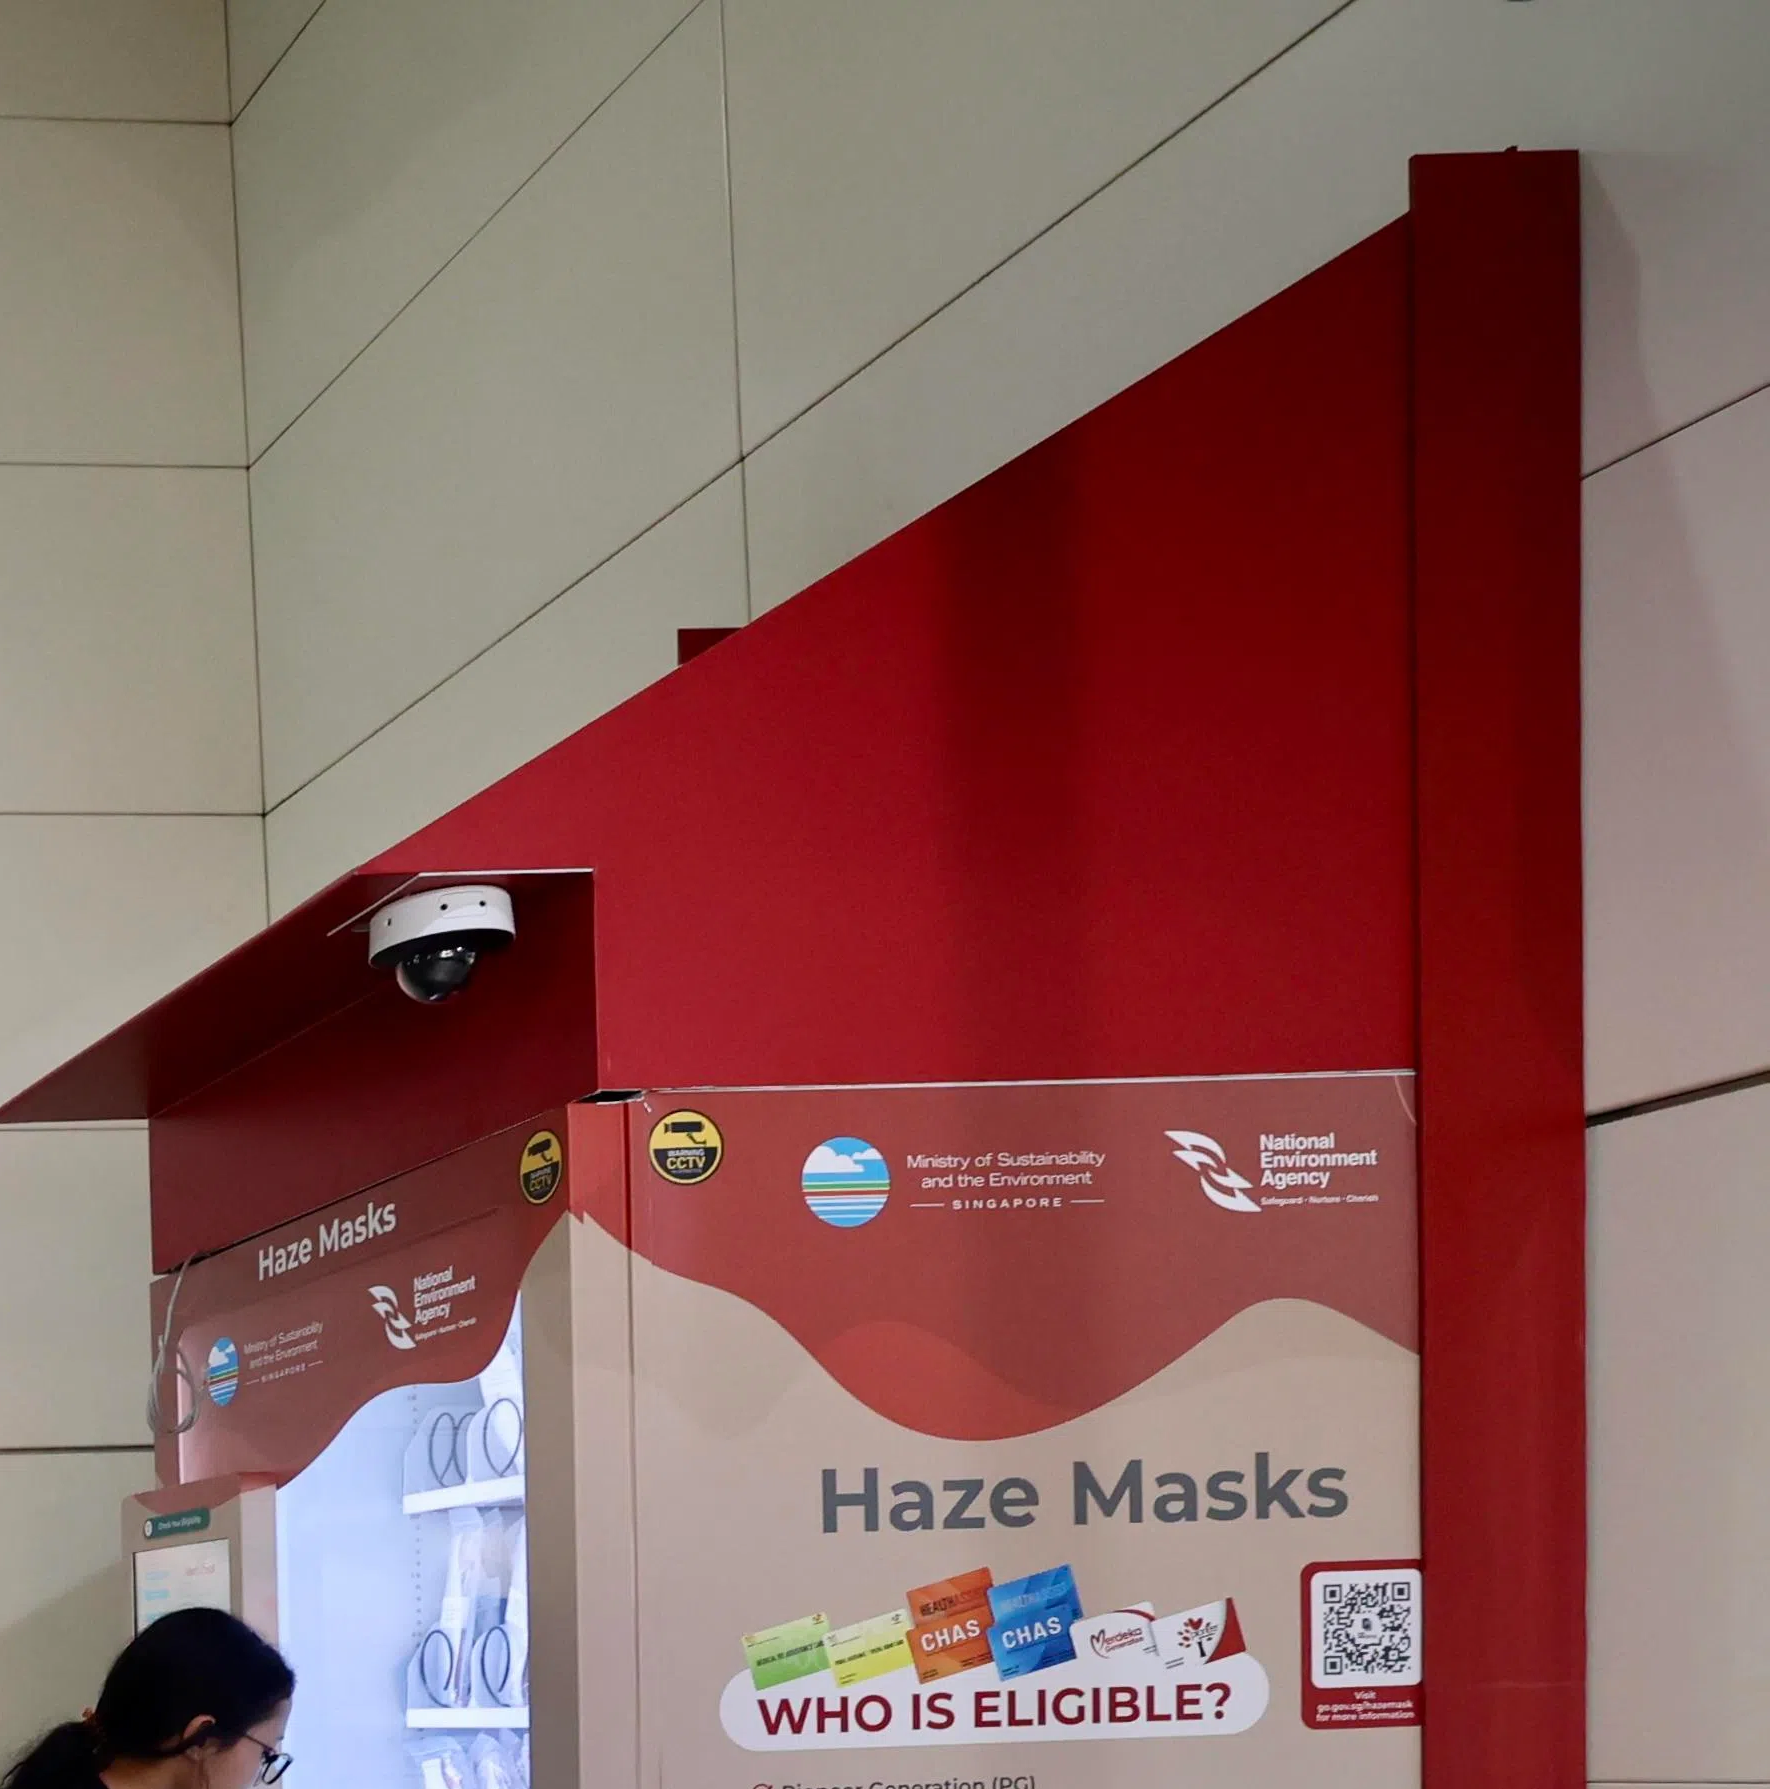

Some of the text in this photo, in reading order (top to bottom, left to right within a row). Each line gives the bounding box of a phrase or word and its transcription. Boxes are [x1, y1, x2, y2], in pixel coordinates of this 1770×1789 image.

[1259, 1132, 1334, 1151] National
[667, 1149, 705, 1157] WARNING
[906, 1149, 1106, 1171] Ministry of Sustainability
[1260, 1150, 1378, 1169] Environment
[666, 1157, 706, 1170] CCTV
[528, 1175, 553, 1192] CCTV
[921, 1170, 1092, 1188] and the Environment
[1260, 1169, 1331, 1189] Agency
[952, 1198, 1062, 1210] SINGAPORE
[258, 1200, 397, 1281] Haze Masks
[413, 1265, 454, 1292] National
[413, 1275, 476, 1309] Environment
[414, 1302, 451, 1325] Agency
[821, 1450, 1350, 1534] Haze Masks
[921, 1619, 981, 1652] CHAS
[1001, 1616, 1062, 1650] CHAS
[1354, 1690, 1377, 1699] Visit
[757, 1682, 1232, 1736] WHO IS ELIGIBLE?
[1332, 1713, 1358, 1721] more
[1358, 1710, 1416, 1720] information
